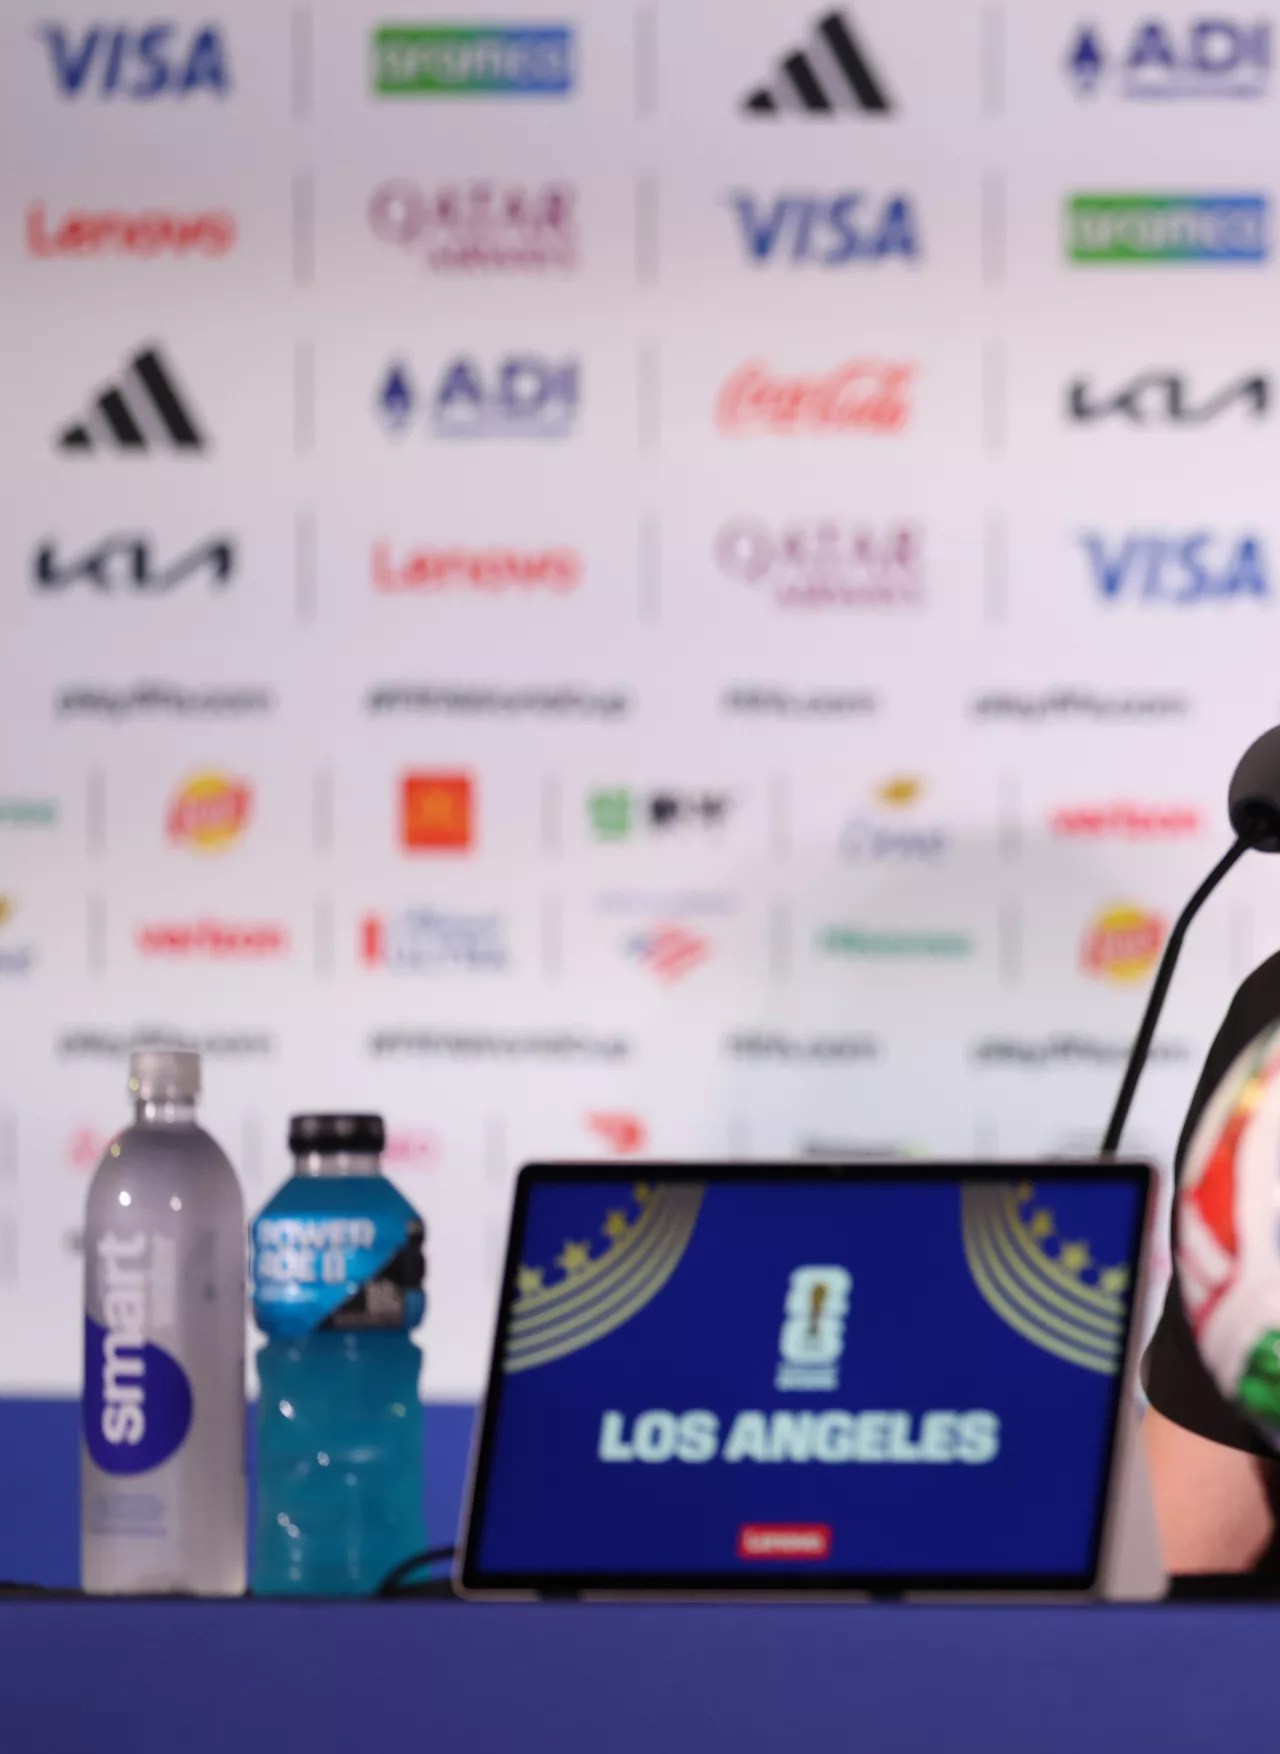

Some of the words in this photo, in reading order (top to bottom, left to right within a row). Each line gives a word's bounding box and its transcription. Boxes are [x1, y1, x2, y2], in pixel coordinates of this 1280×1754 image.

[43, 23, 230, 100] VISA
[1121, 18, 1271, 68] ADI
[26, 202, 236, 258] Lenovo
[730, 191, 921, 267] VISA
[435, 357, 578, 413] ADI
[371, 544, 580, 593] Lenovo
[1080, 531, 1271, 606] VISA
[98, 1231, 147, 1446] smart
[599, 1409, 720, 1464] LOS
[722, 1409, 1001, 1464] ANGELES
